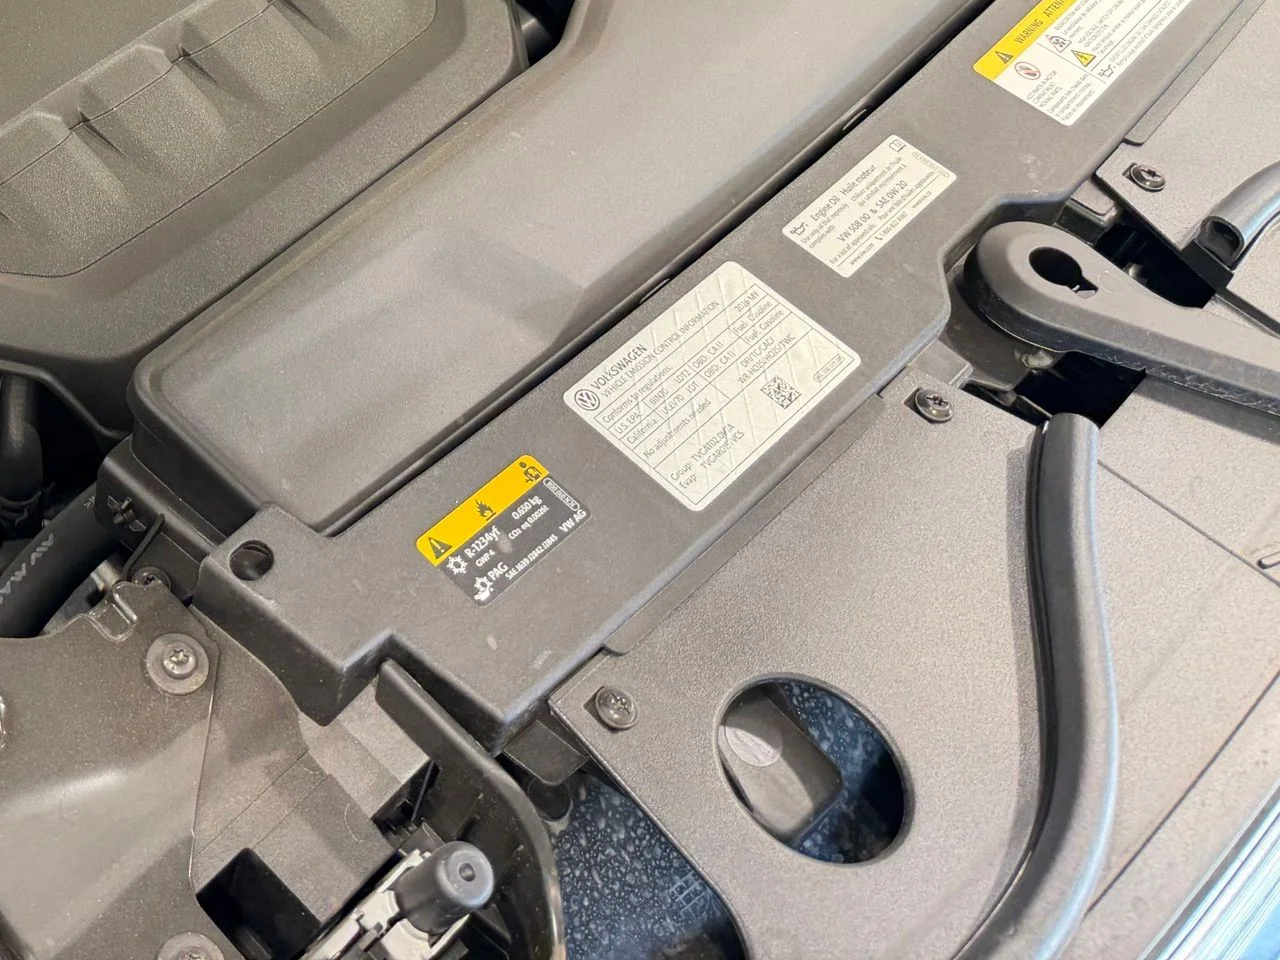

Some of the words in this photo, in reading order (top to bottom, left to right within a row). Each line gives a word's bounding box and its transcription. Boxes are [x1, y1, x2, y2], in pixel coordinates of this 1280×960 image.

[1013, 18, 1043, 43] WARNING
[839, 181, 858, 195] Huile
[854, 164, 876, 183] moteur
[809, 203, 833, 221] Engine
[828, 194, 840, 205] Oil
[836, 229, 851, 241] VW
[847, 219, 863, 232] 508
[859, 212, 871, 222] 00
[874, 196, 890, 208] SAE
[885, 179, 907, 199] 0W-20
[746, 290, 759, 301] MY
[758, 310, 784, 330] Gasoline
[600, 375, 628, 397] VEHICLE
[624, 352, 656, 378] EMISSION
[652, 331, 682, 355] CONTROL
[678, 300, 719, 334] INFORMATION
[707, 345, 719, 355] CA
[719, 355, 731, 364] CA
[590, 343, 647, 389] VOLKSWAGEN
[673, 368, 692, 384] LDT2
[685, 380, 699, 393] LDT
[602, 398, 633, 423] Conforms
[630, 391, 639, 400] to
[642, 448, 655, 458] No
[653, 417, 690, 450] adjustments
[511, 501, 531, 519] 0.650
[527, 495, 542, 505] kg
[520, 521, 531, 529] eq
[558, 517, 575, 531] VW
[573, 508, 586, 522] AG
[463, 524, 500, 558] R-1234yf
[475, 552, 490, 566] GWP
[504, 567, 518, 580] SAE
[515, 557, 530, 571] J639
[527, 545, 544, 561] J2842
[541, 533, 557, 549] J2845
[487, 561, 508, 580] PAG
